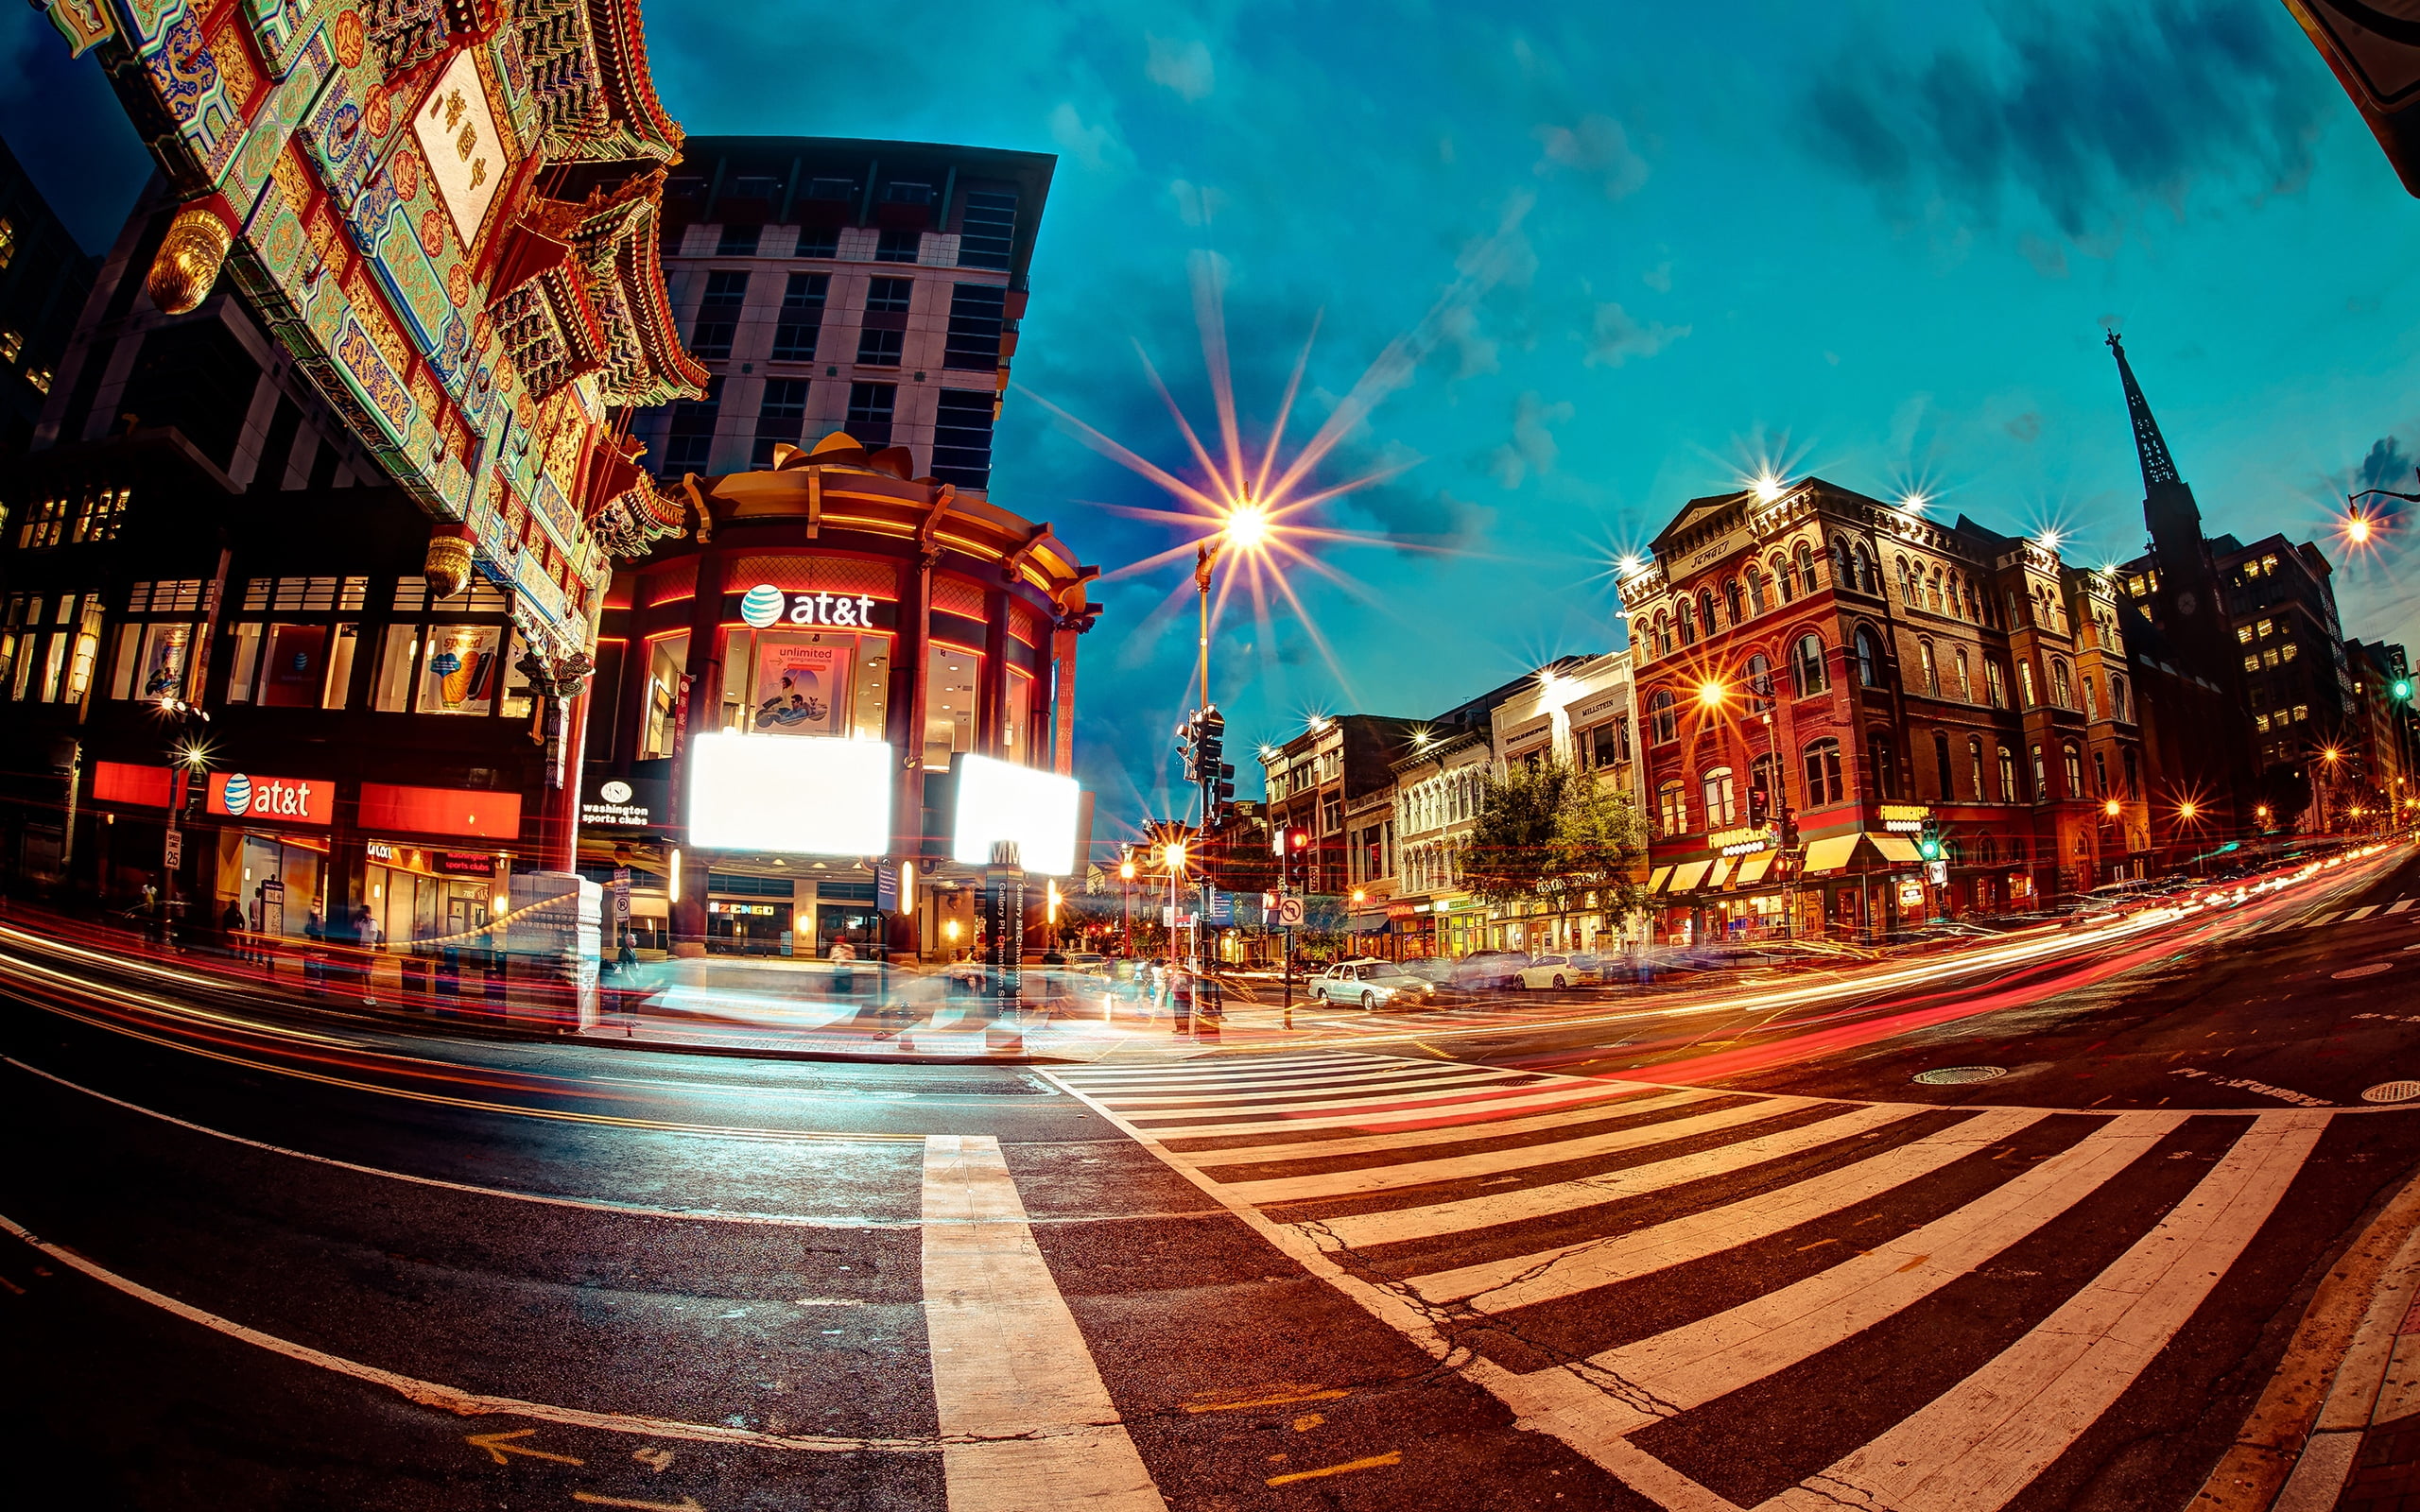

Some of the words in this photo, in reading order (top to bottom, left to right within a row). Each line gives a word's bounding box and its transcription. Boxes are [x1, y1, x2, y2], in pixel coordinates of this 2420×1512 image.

[790, 591, 874, 627] at&t
[780, 647, 832, 659] unlimited
[1582, 699, 1614, 717] MILLSTEIN
[254, 781, 310, 816] at&t
[582, 804, 648, 816] washington
[582, 814, 615, 824] sports
[618, 816, 648, 826] clubs
[168, 833, 181, 843] SPEED
[166, 851, 179, 866] 25
[469, 863, 490, 871] clubs
[997, 883, 1006, 918] Gallery
[1014, 884, 1023, 918] Gallery
[1014, 989, 1023, 1024] Station
